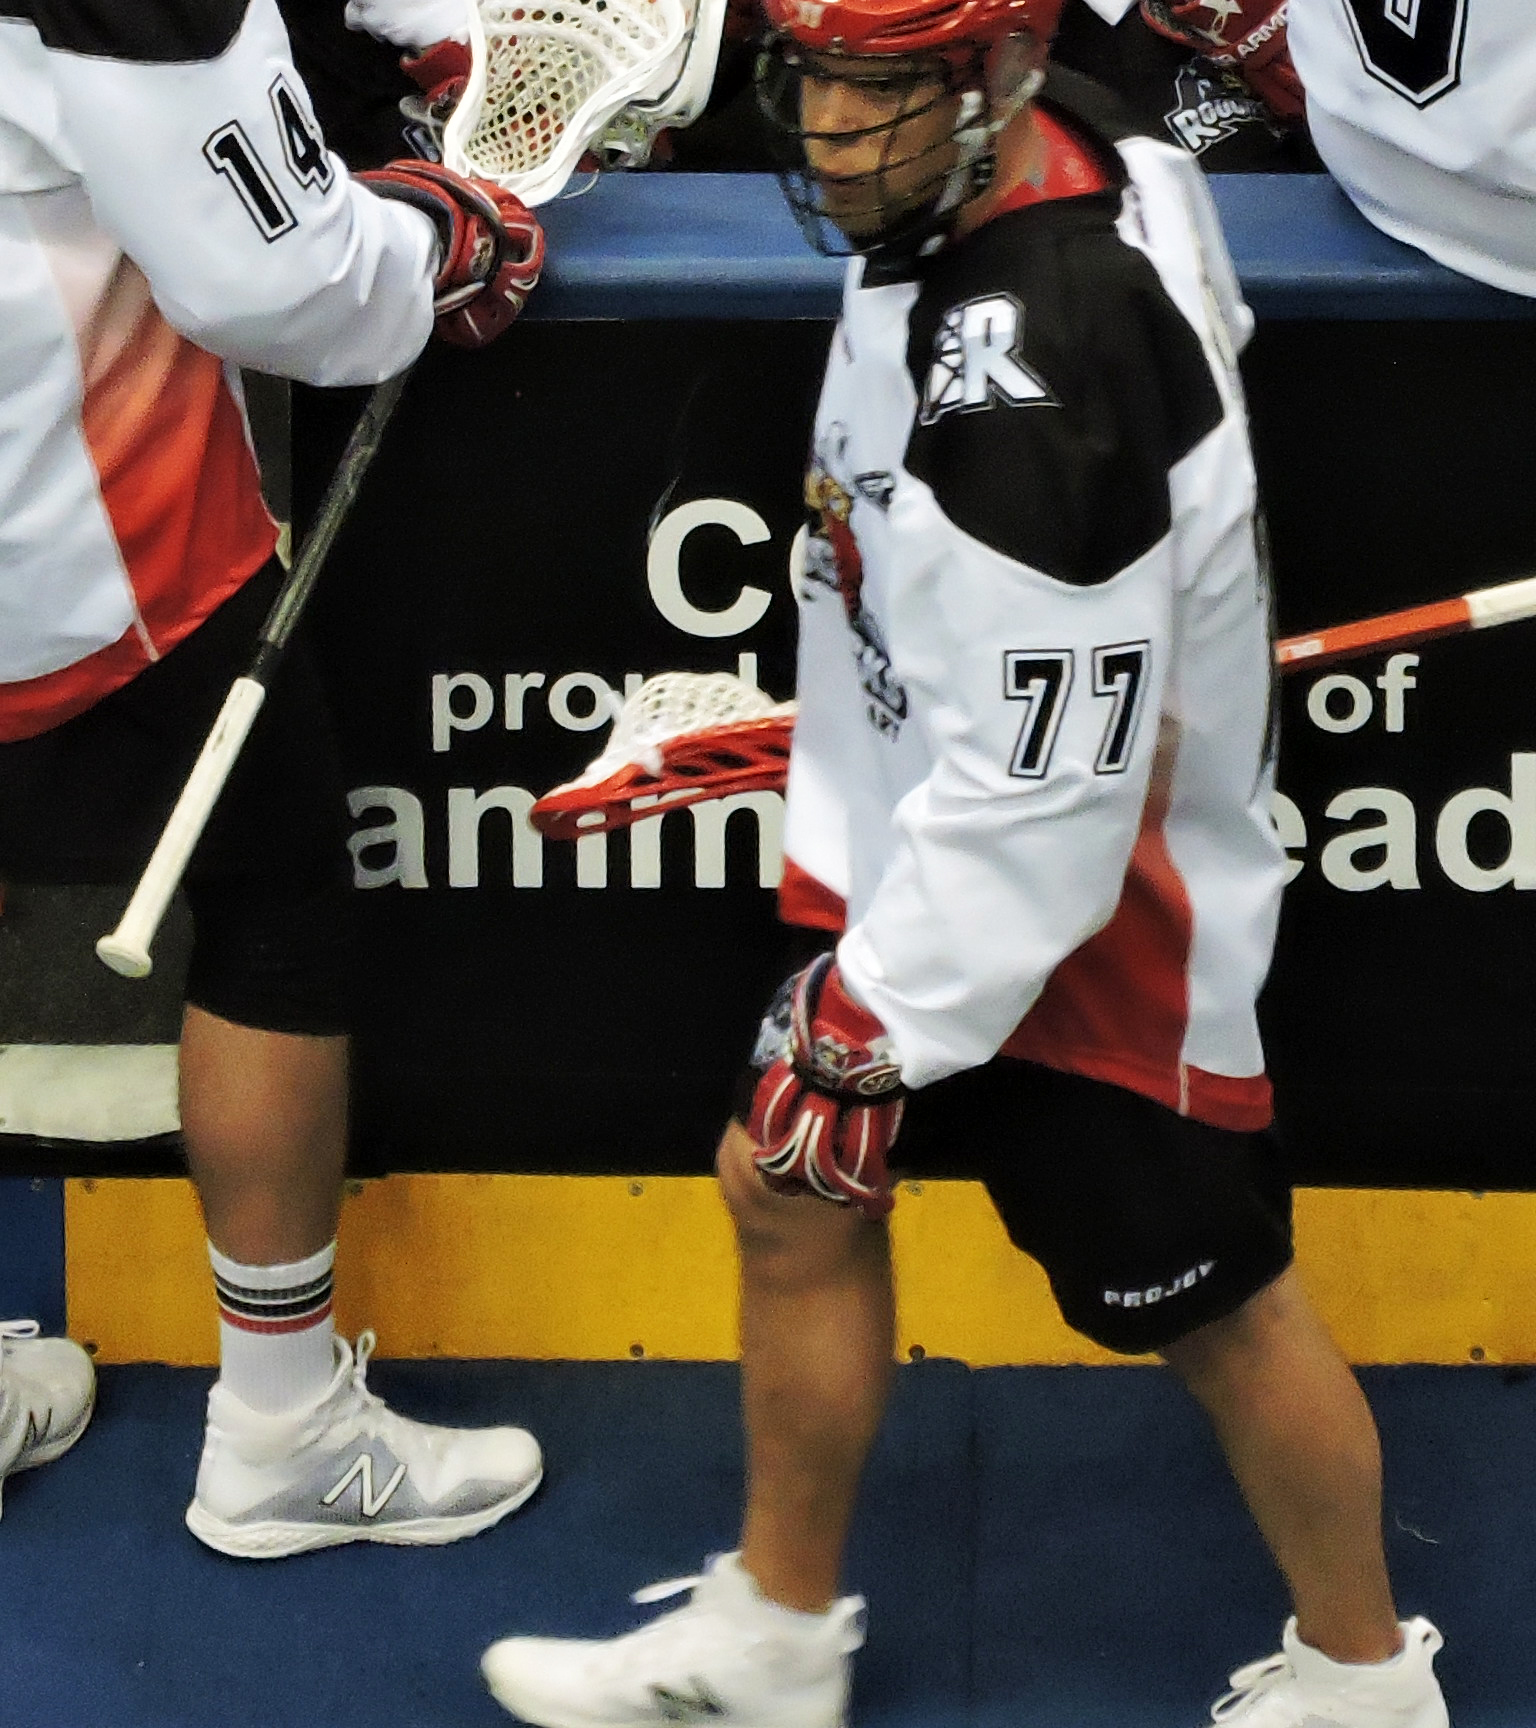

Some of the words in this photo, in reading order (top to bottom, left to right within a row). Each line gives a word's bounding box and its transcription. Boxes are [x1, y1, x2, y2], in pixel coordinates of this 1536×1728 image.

[203, 73, 335, 243] 14
[1002, 639, 1153, 781] 77
[1306, 654, 1420, 733] of
[1104, 1260, 1216, 1308] PROJOY
